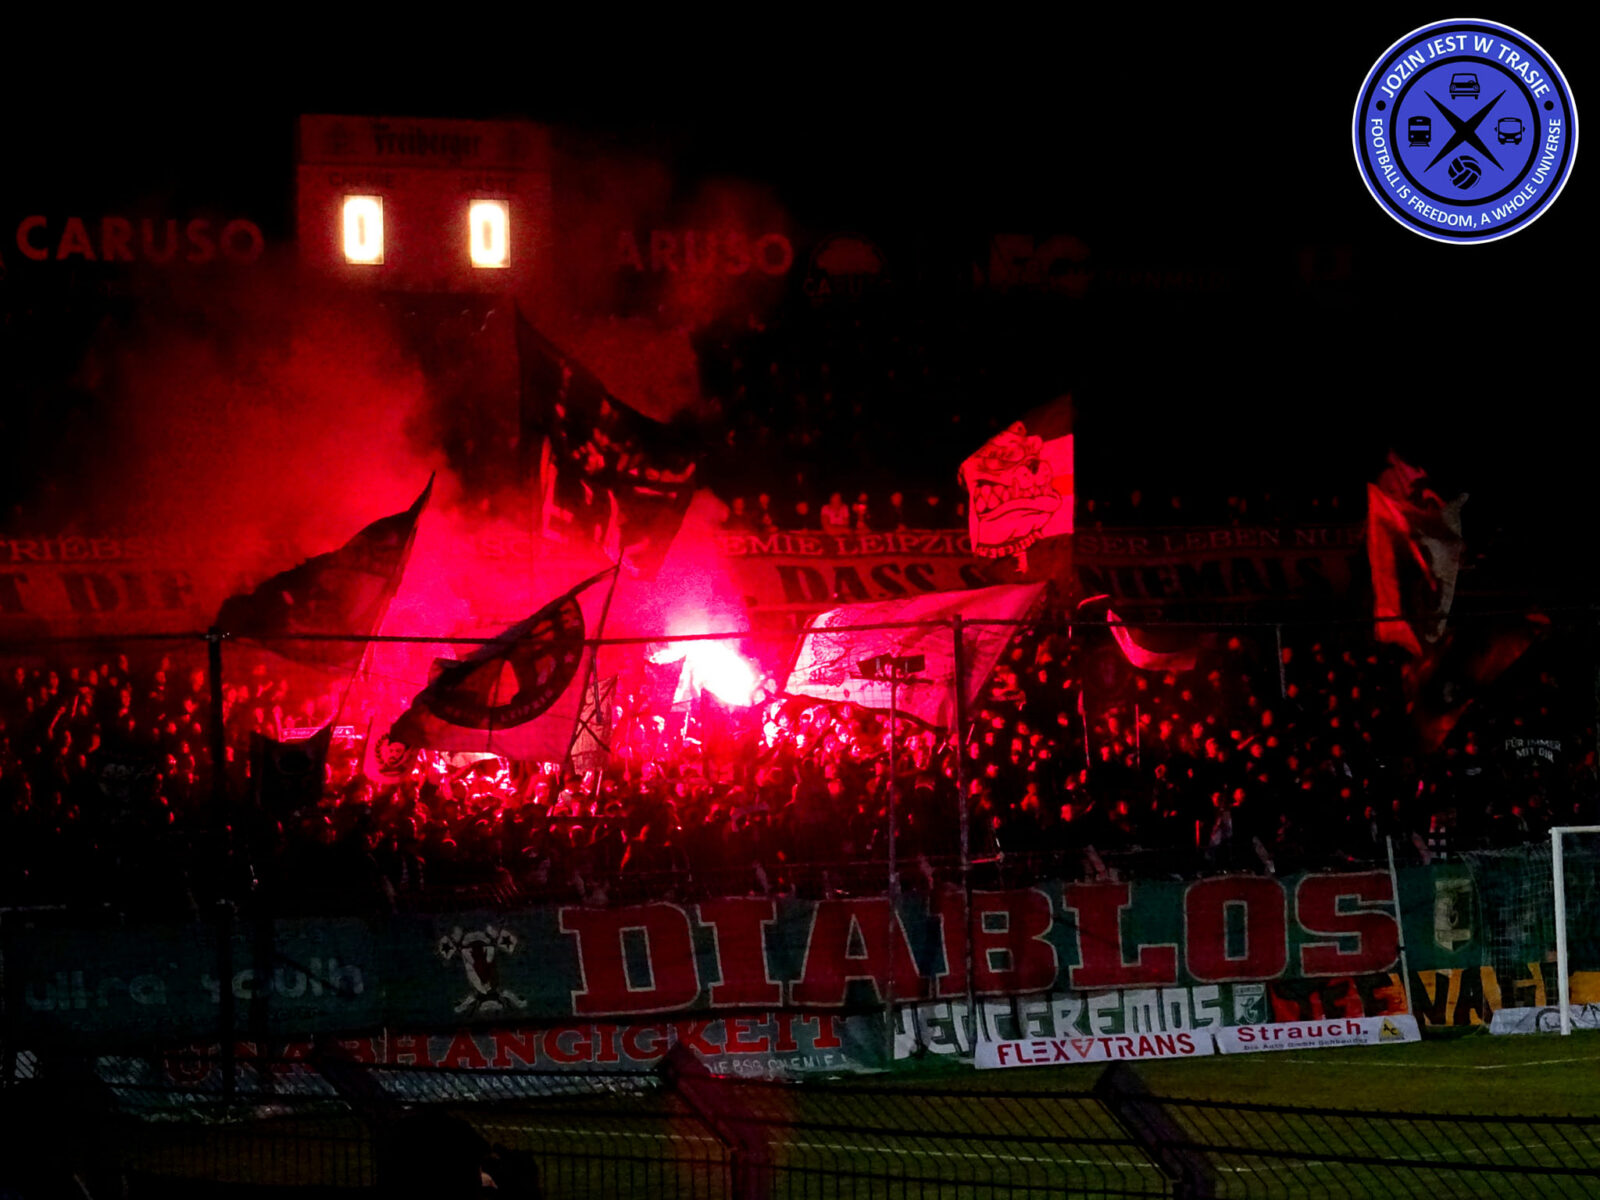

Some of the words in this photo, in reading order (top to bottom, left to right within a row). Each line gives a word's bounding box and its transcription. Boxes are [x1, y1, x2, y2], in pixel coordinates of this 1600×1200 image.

[15, 214, 265, 263] CARUSO
[343, 197, 384, 264] 0
[470, 201, 510, 267] 0
[617, 230, 795, 276] ARUSO
[722, 533, 825, 557] EMIE
[558, 870, 1402, 1018] DIABLOS
[1236, 1020, 1369, 1042] Strauch.
